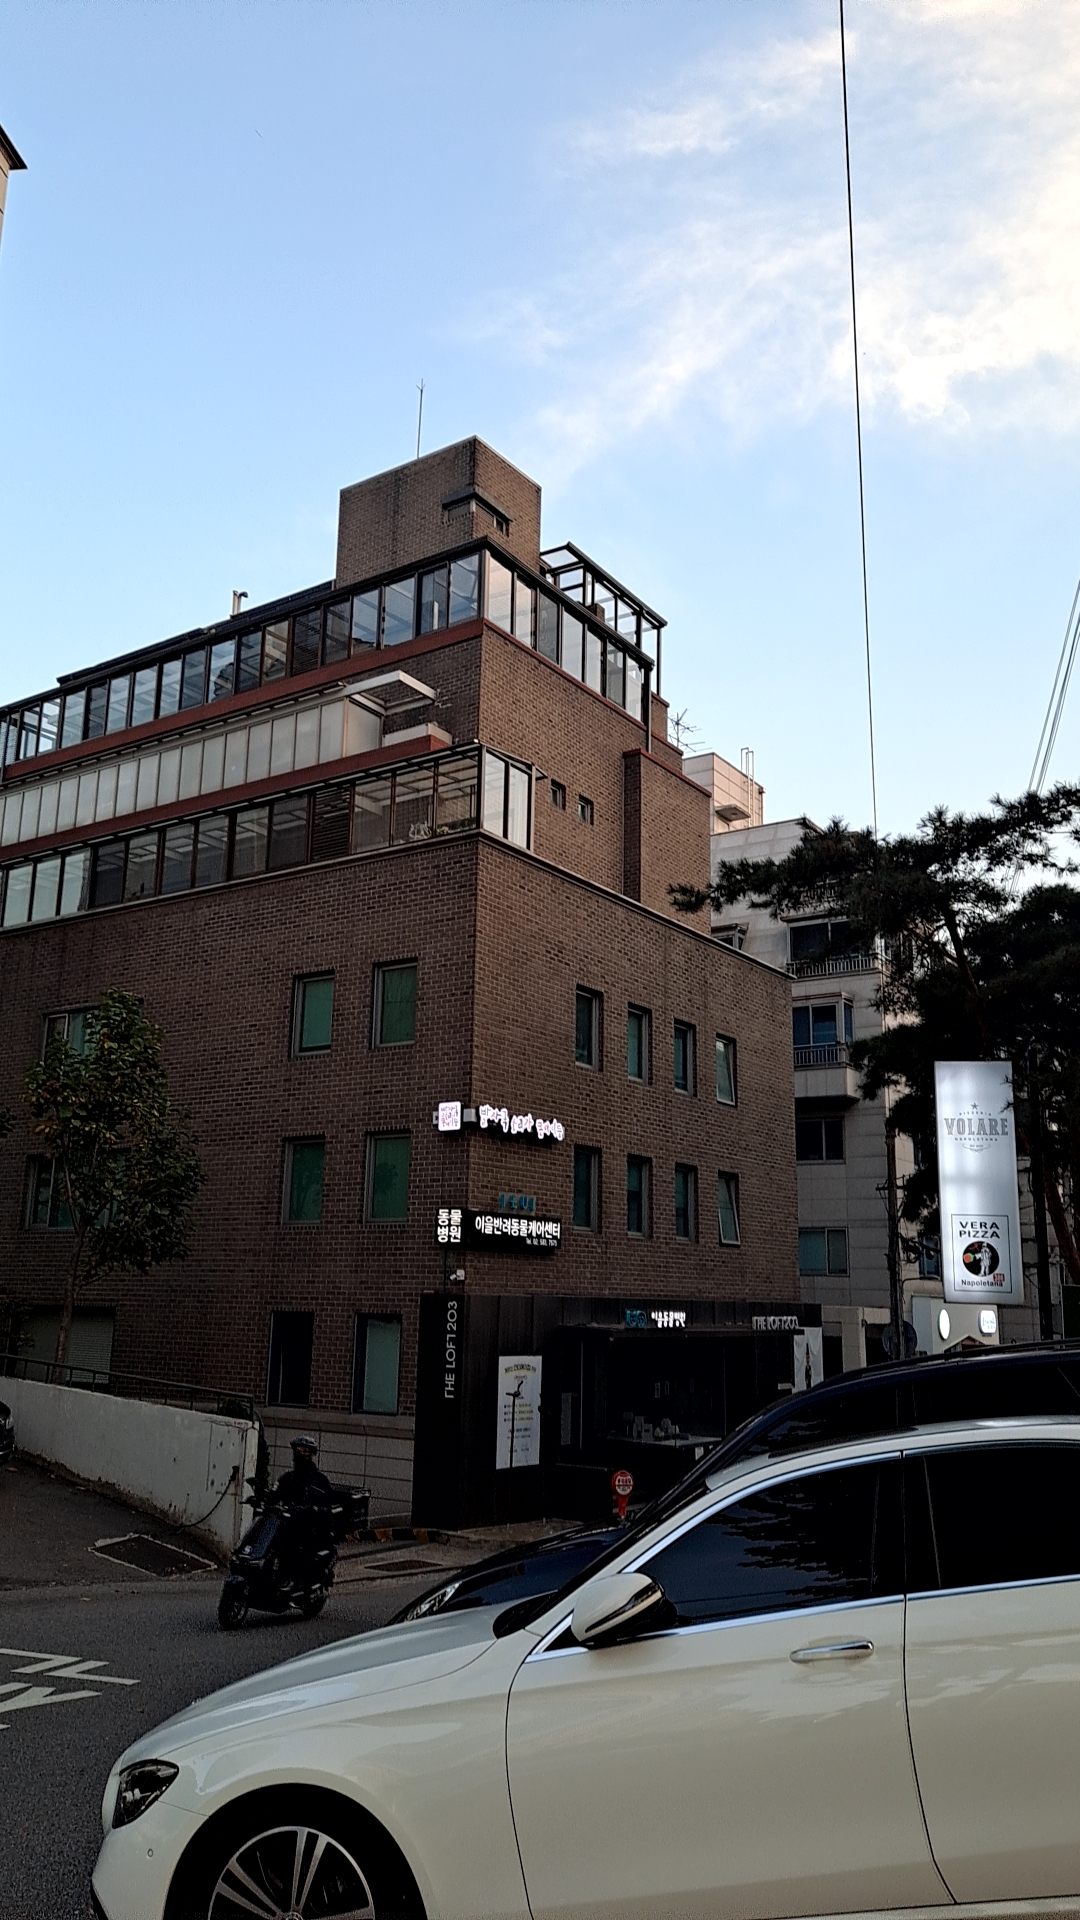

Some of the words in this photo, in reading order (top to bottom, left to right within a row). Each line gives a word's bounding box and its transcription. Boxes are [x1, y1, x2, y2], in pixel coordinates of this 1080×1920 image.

[479, 1104, 509, 1132] 발자국
[943, 1117, 1009, 1136] VOLARE
[437, 1208, 463, 1226] 동물
[959, 1221, 1000, 1230] VERA
[437, 1226, 462, 1243] 병원
[475, 1215, 561, 1239] 이을반려동물케어센터
[959, 1230, 1001, 1239] PIZZA
[961, 1279, 1003, 1288] Napoletana
[752, 1315, 766, 1330] THE
[444, 1373, 455, 1399] THE
